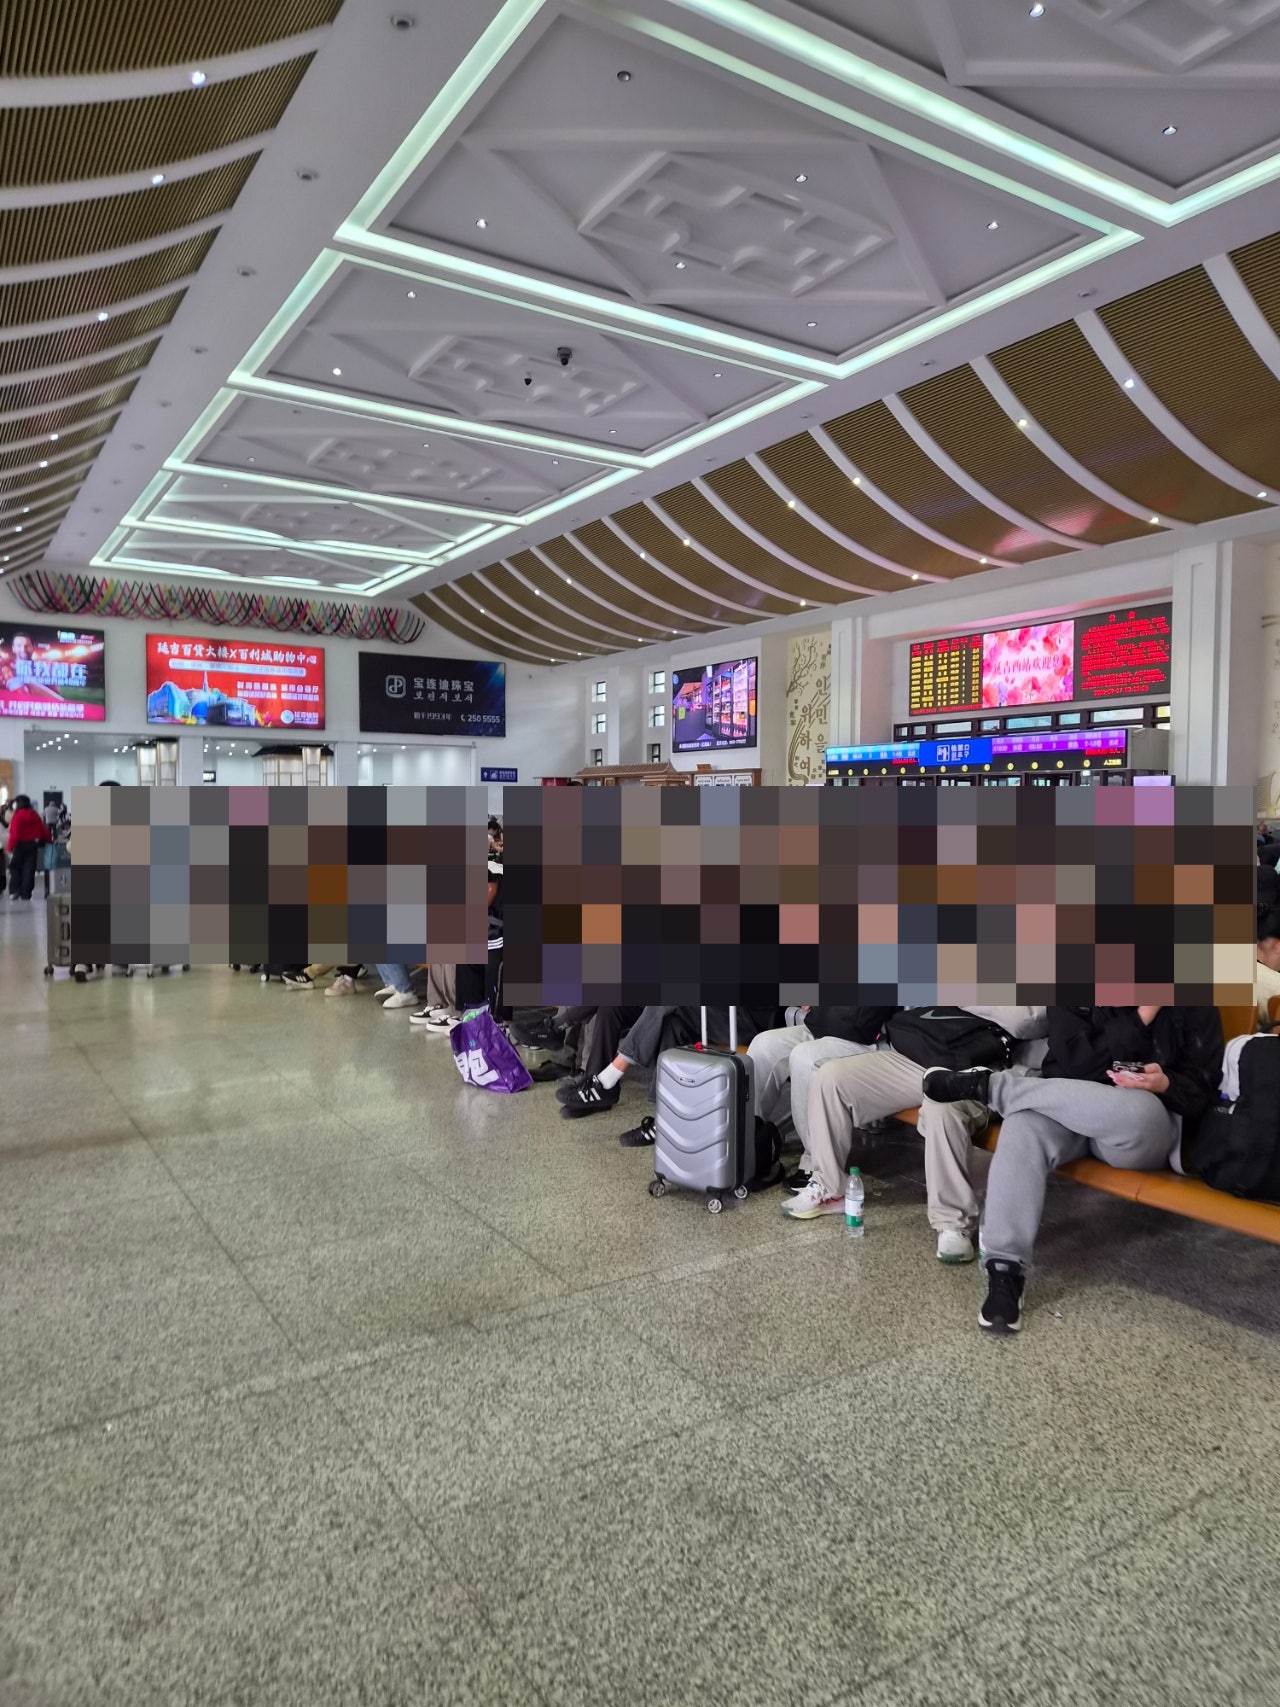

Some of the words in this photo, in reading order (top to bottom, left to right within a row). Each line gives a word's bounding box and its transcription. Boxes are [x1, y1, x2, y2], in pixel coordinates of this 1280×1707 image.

[413, 677, 475, 692] 宝连迪珠宝
[467, 714, 482, 723] 250
[482, 714, 501, 723] 5555
